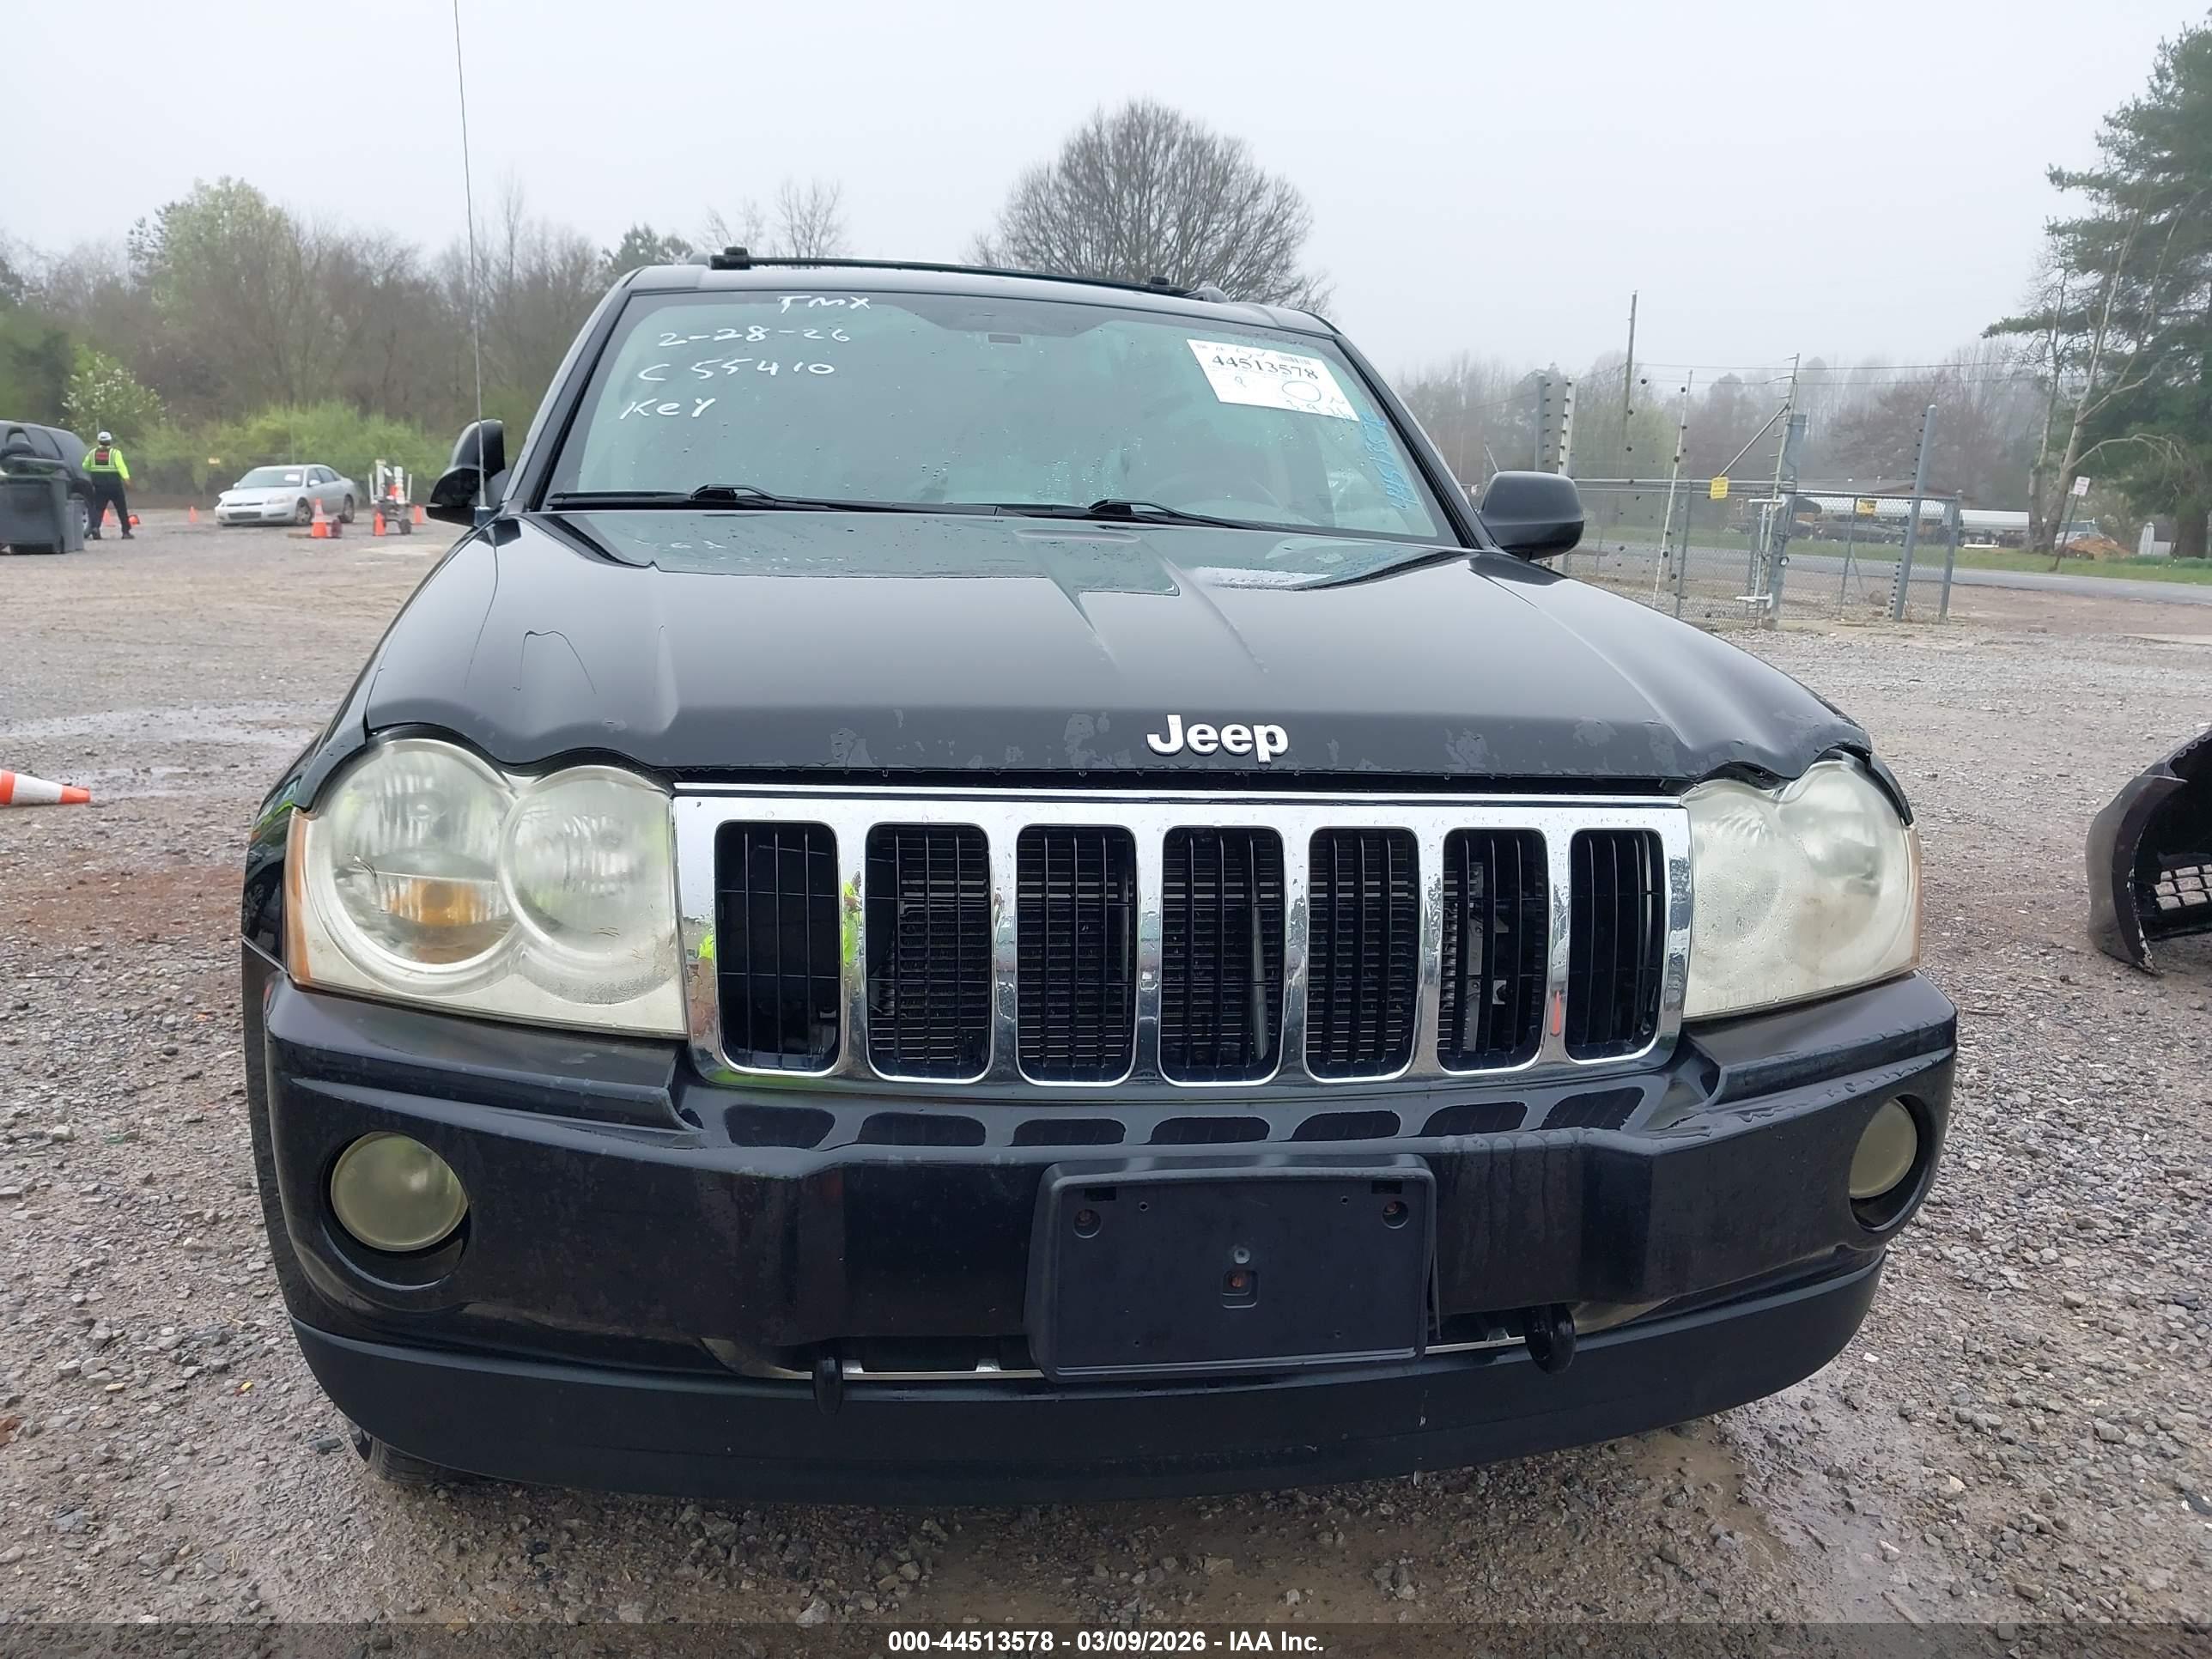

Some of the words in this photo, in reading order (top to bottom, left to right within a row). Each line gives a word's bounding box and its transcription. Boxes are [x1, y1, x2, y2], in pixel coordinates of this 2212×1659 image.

[776, 295, 871, 314] TMX
[658, 325, 851, 347] 2-28-26
[1212, 355, 1319, 380] 44513578
[1146, 714, 1289, 764] Jeep
